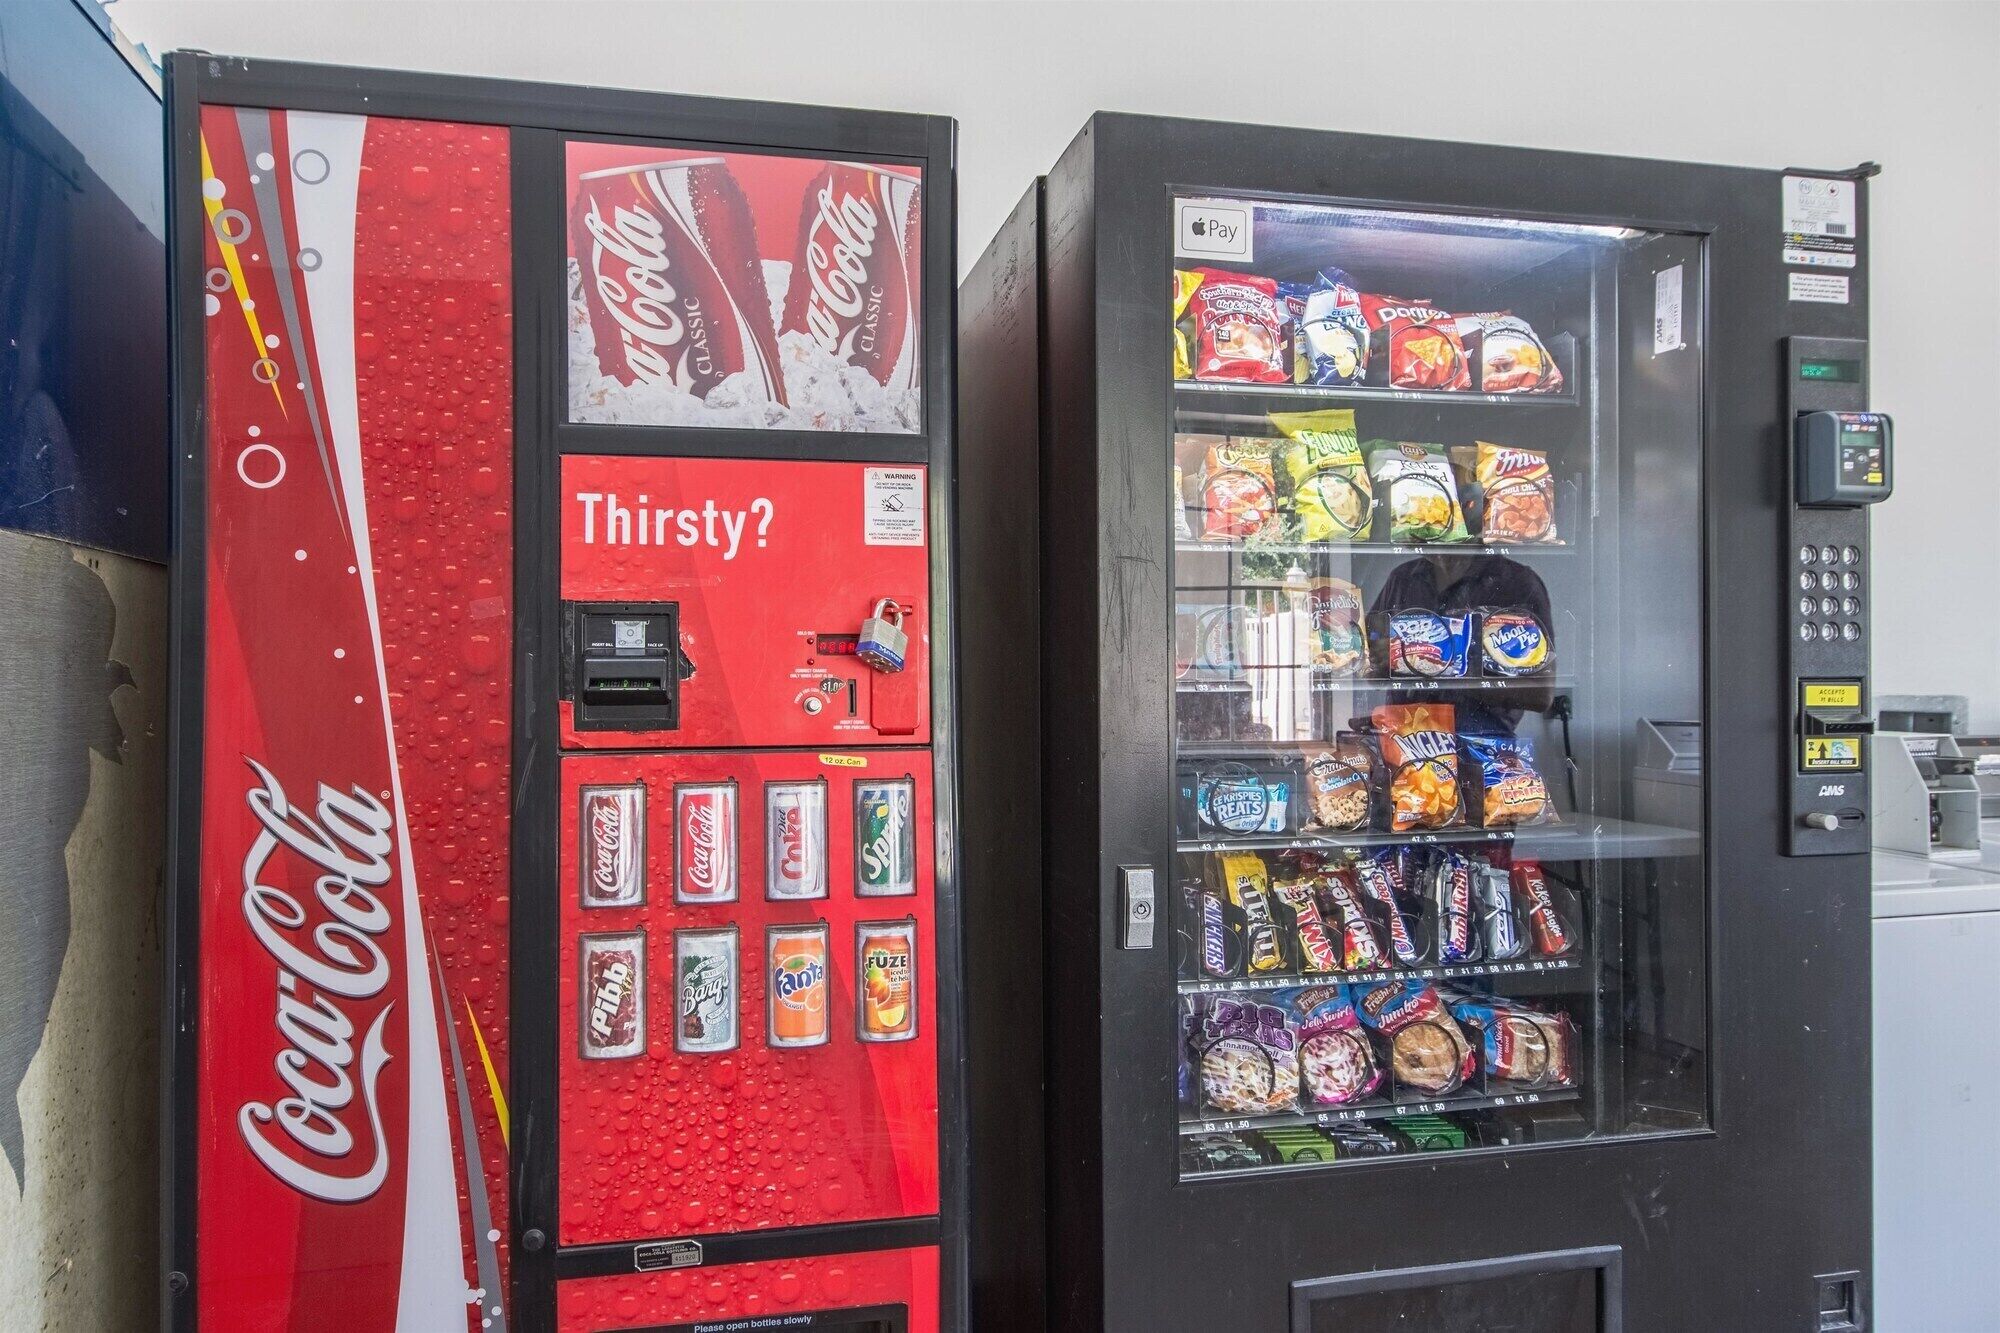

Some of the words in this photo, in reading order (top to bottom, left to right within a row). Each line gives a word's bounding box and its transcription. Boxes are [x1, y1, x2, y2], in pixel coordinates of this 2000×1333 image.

[1209, 220, 1237, 243] Pay
[860, 285, 883, 353] CLASSIC
[1378, 307, 1451, 322] Doritos
[684, 297, 713, 376] CLASSIC
[1400, 460, 1439, 470] Kettle
[1522, 480, 1547, 491] CHESE
[577, 493, 774, 561] Thirsty?
[1490, 624, 1526, 648] Moon
[1518, 631, 1538, 650] Pie
[878, 645, 902, 664] Master
[1395, 645, 1436, 656] Sawberry
[1456, 654, 1462, 663] 2
[1318, 777, 1352, 792] Chocolate
[1819, 785, 1845, 796] AMS
[1224, 792, 1261, 803] KRISPIES
[778, 809, 786, 838] Diet
[593, 802, 620, 892] Coca-Cola
[688, 802, 716, 888] Coca-Cola
[781, 807, 806, 880] Coke
[1297, 900, 1337, 971] TWIX
[868, 954, 907, 969] FUZE
[1534, 962, 1543, 970] 59
[236, 752, 396, 1204] Coca-Cola
[775, 962, 822, 1000] Fanta
[590, 962, 628, 1038] Pibb
[782, 1000, 804, 1010] ORANGE
[1364, 981, 1403, 1011] Freshley's
[1214, 998, 1287, 1029] BIG
[1302, 1016, 1323, 1030] Jelly
[1323, 1005, 1350, 1023] Swirl
[1378, 998, 1420, 1029] Jumbo
[1202, 1018, 1296, 1052] TEXAS
[1217, 1040, 1260, 1052] Cinnamon
[1318, 1114, 1328, 1122] 65
[694, 1324, 724, 1333] Please
[726, 1321, 749, 1331] open
[751, 1318, 782, 1328] bottles
[784, 1315, 812, 1324] slowly
